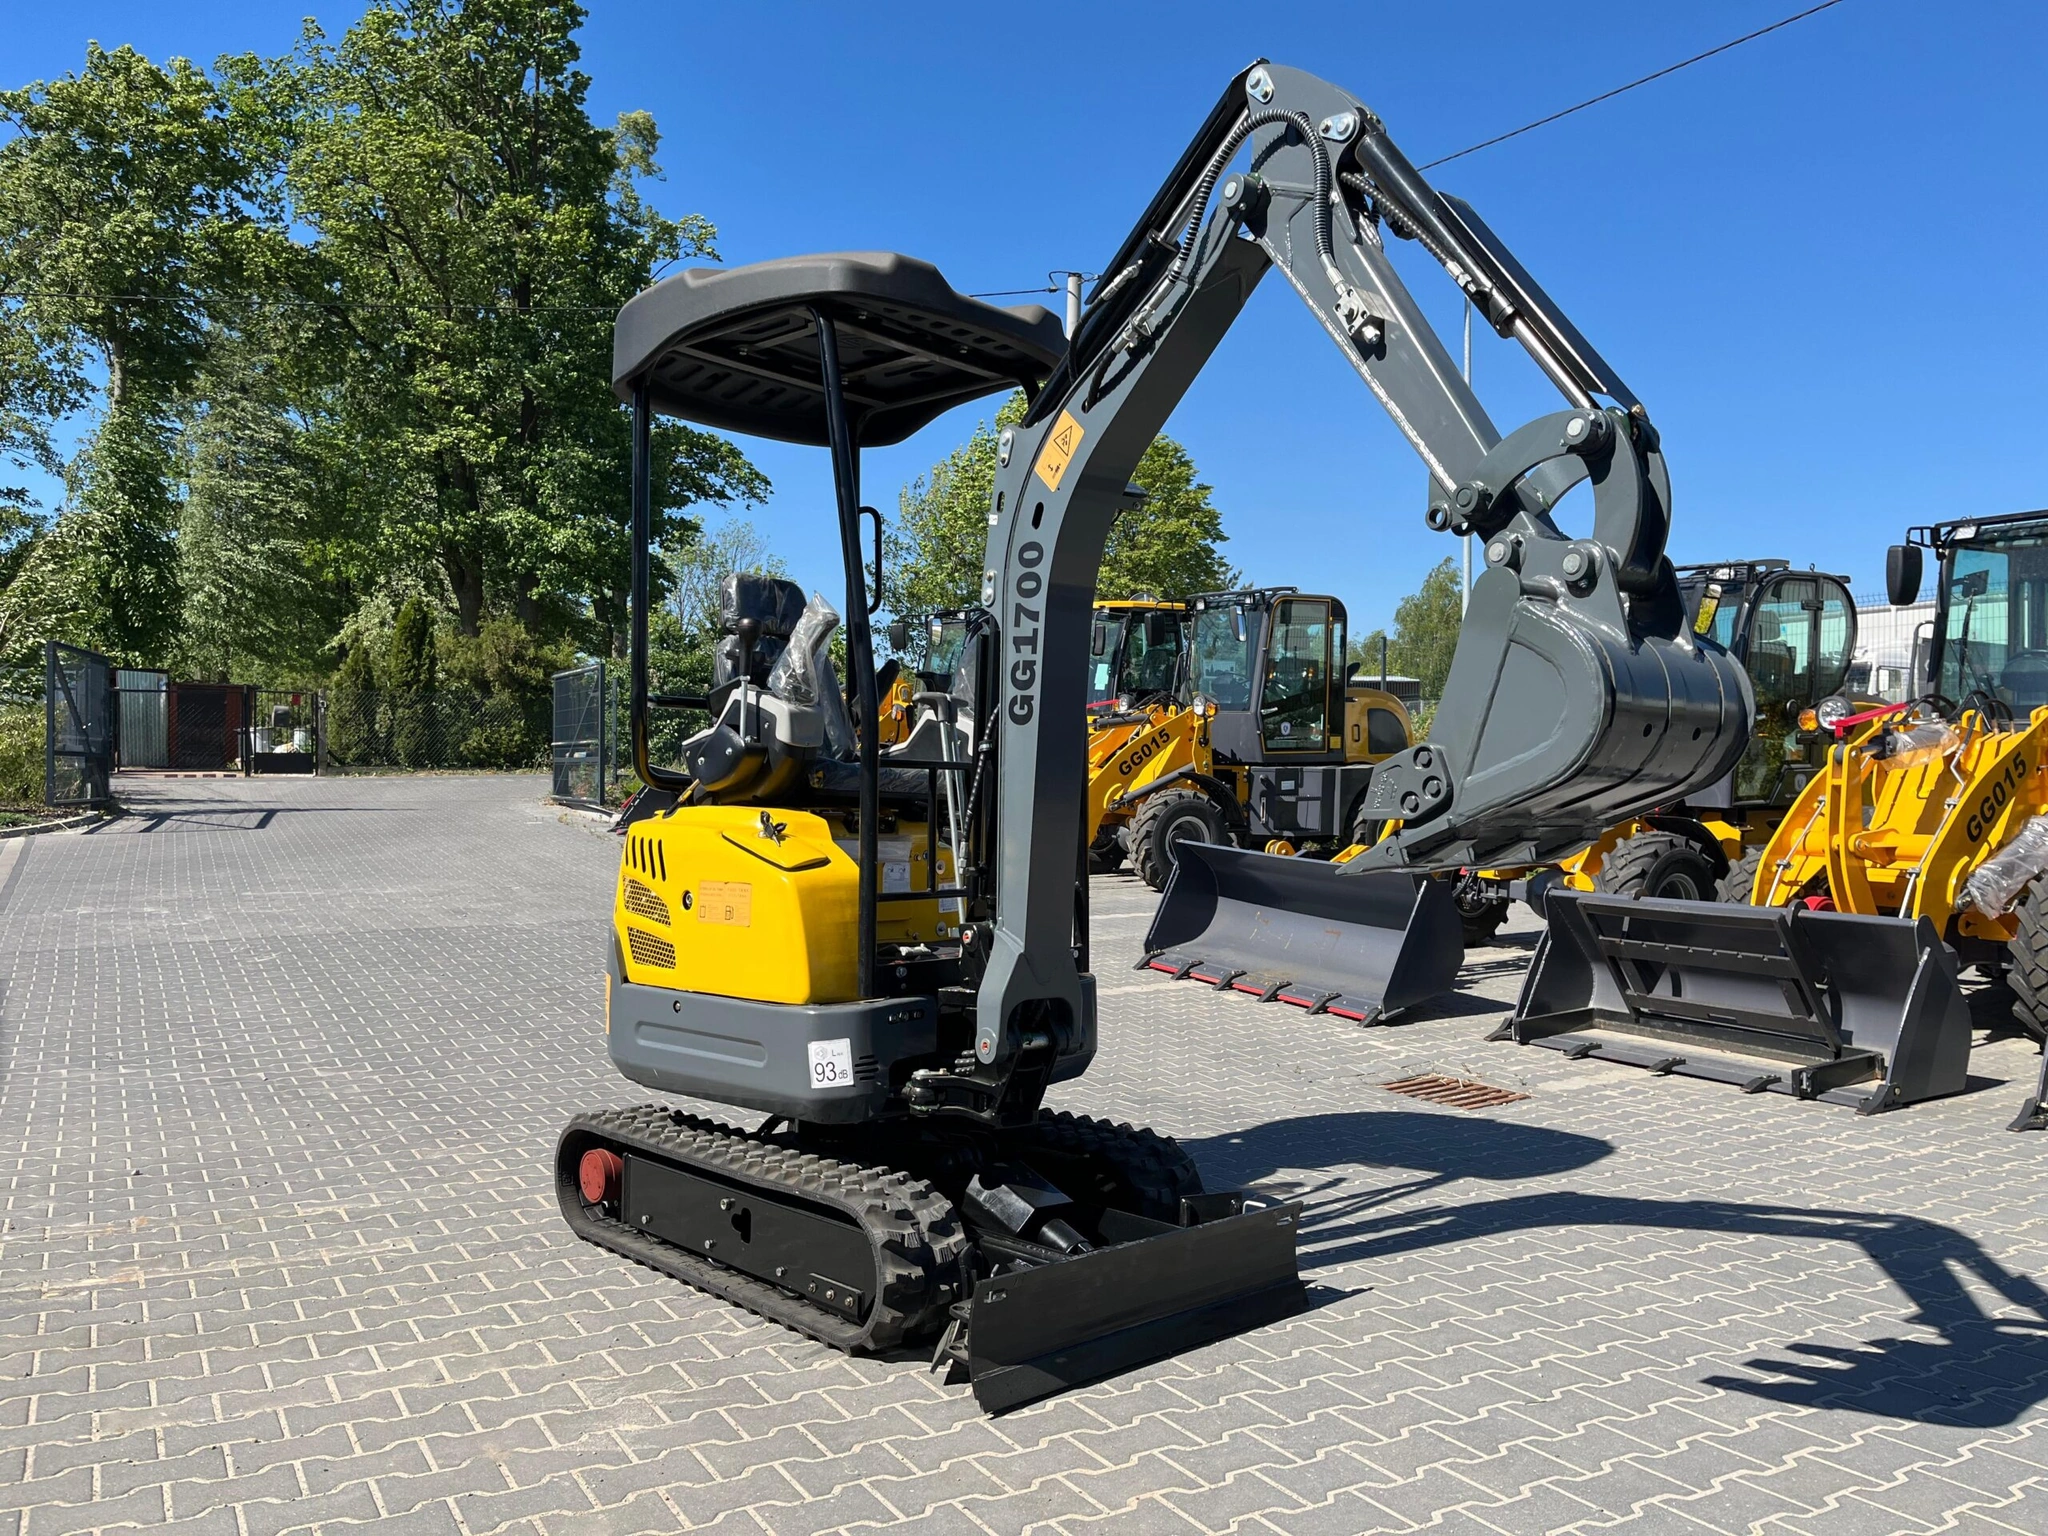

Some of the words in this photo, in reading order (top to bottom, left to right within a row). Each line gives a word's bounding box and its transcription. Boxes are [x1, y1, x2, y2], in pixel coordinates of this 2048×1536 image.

[1008, 541, 1044, 726] GG1700
[1118, 728, 1170, 776] GG015
[1966, 751, 2027, 843] GG015
[814, 1061, 837, 1082] 93
[838, 1069, 849, 1080] dB
